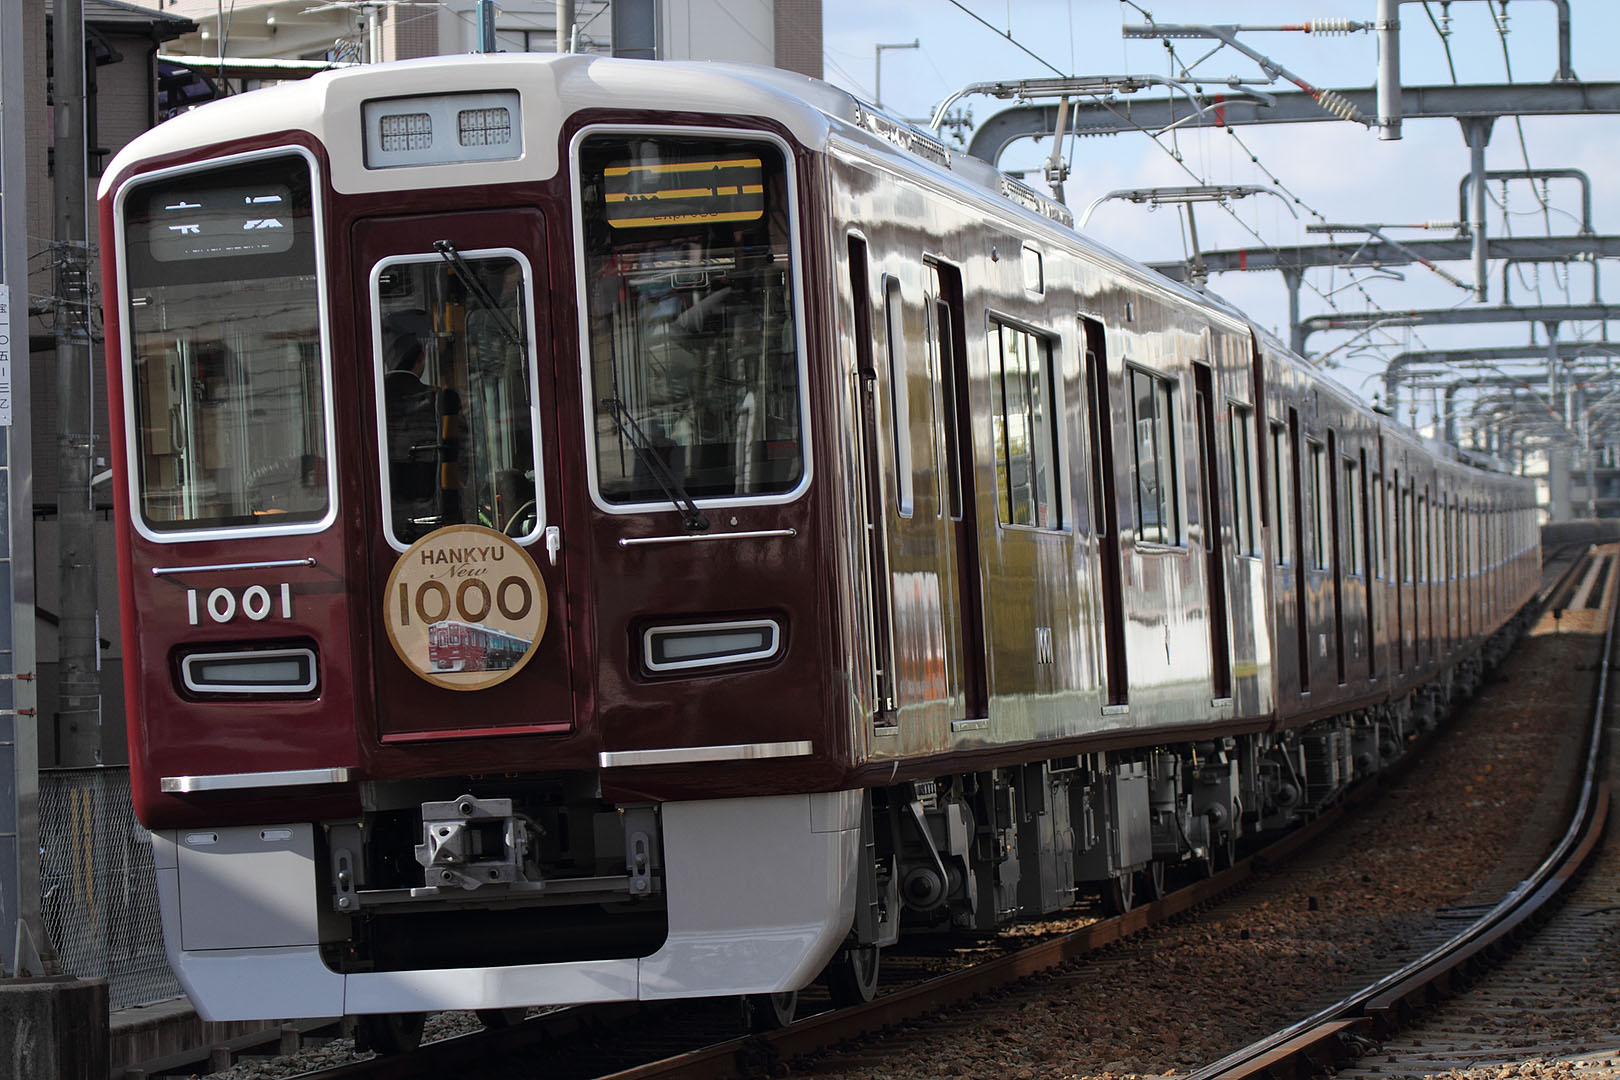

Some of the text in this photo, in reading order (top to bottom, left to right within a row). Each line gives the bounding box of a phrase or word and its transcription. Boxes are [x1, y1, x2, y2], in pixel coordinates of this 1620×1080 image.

[421, 546, 505, 565] HANKYU
[430, 562, 489, 579] New
[187, 583, 291, 625] 1001
[399, 576, 532, 625] 1000
